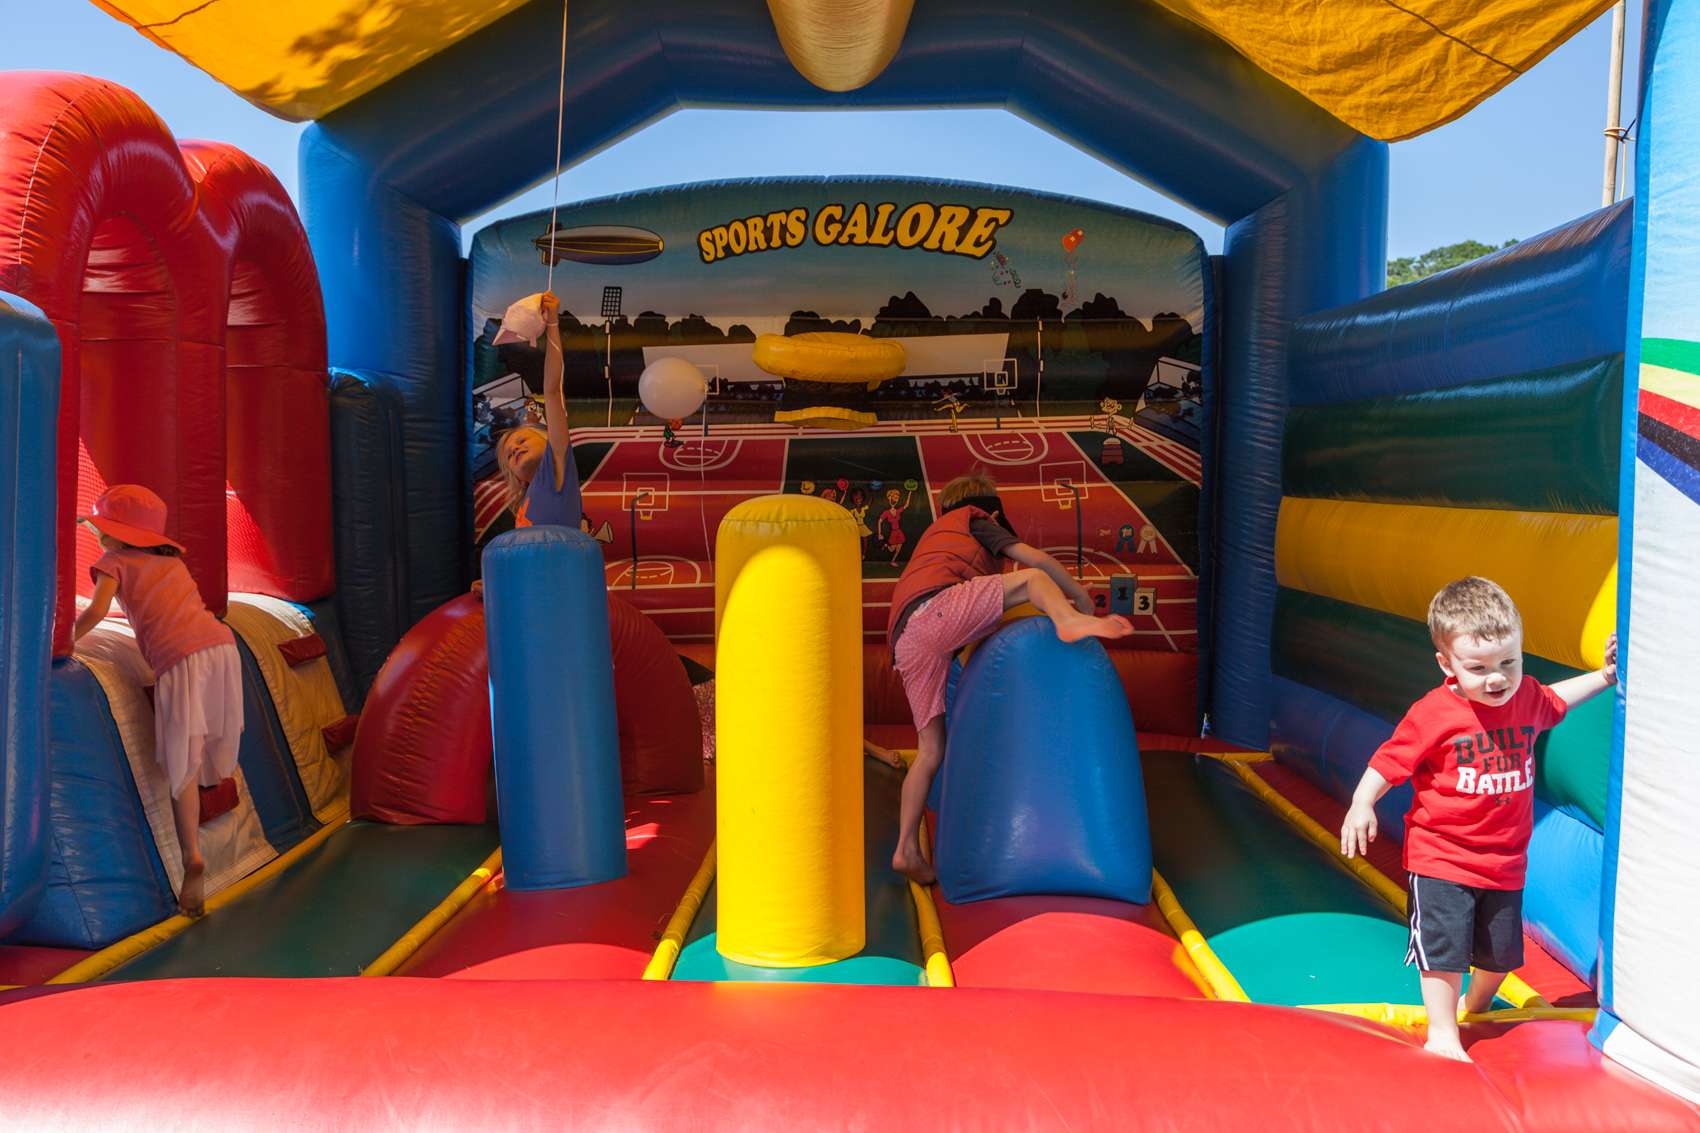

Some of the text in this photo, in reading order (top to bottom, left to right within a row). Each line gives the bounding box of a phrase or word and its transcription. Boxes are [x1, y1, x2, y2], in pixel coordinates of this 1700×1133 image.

[698, 202, 1013, 263] SPORTS GALORE
[1117, 587, 1129, 600] 1
[1138, 595, 1150, 610] 3
[1454, 726, 1534, 764] BUILT
[1483, 752, 1521, 773] FOR
[1456, 757, 1534, 795] BATTLE
